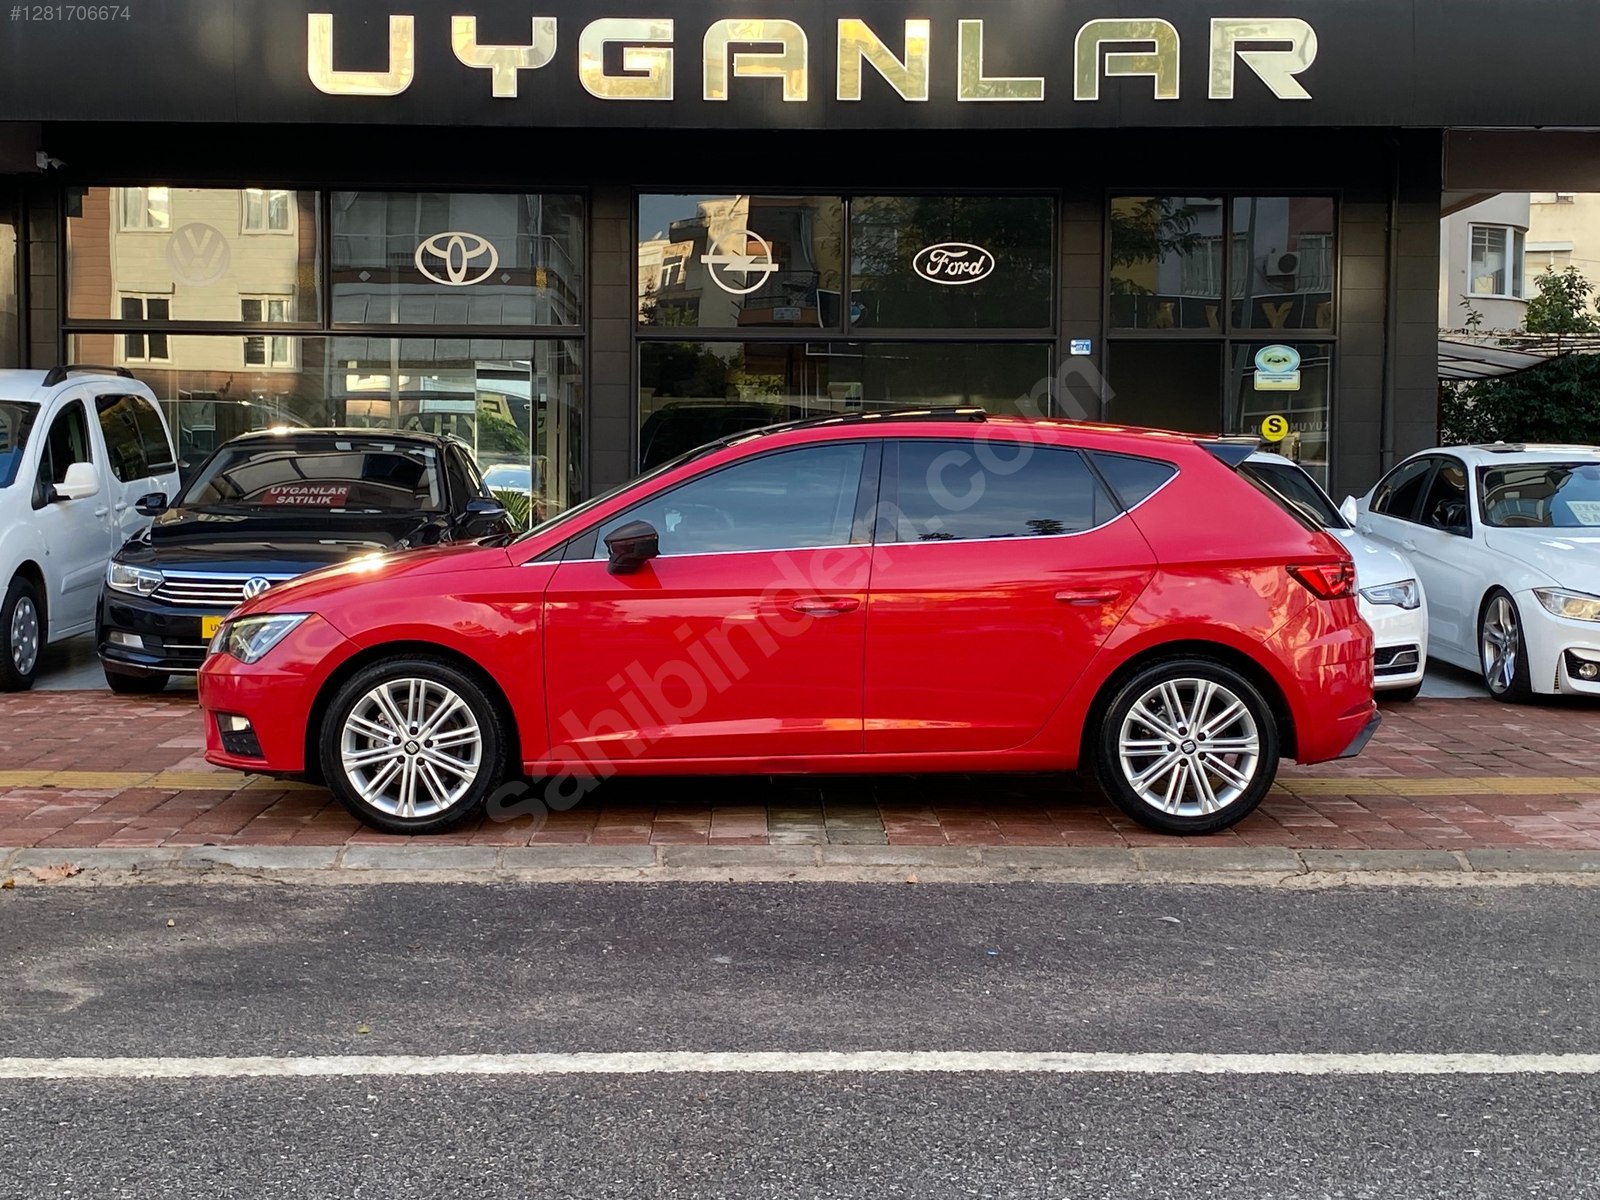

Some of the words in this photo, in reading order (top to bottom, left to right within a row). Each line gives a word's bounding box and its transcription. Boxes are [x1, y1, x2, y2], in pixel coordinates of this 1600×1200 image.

[307, 13, 1319, 103] UYGANLAR
[926, 249, 986, 275] Ford
[1268, 418, 1282, 433] S
[270, 487, 347, 495] UYGANLAR
[276, 496, 332, 504] SATILIK
